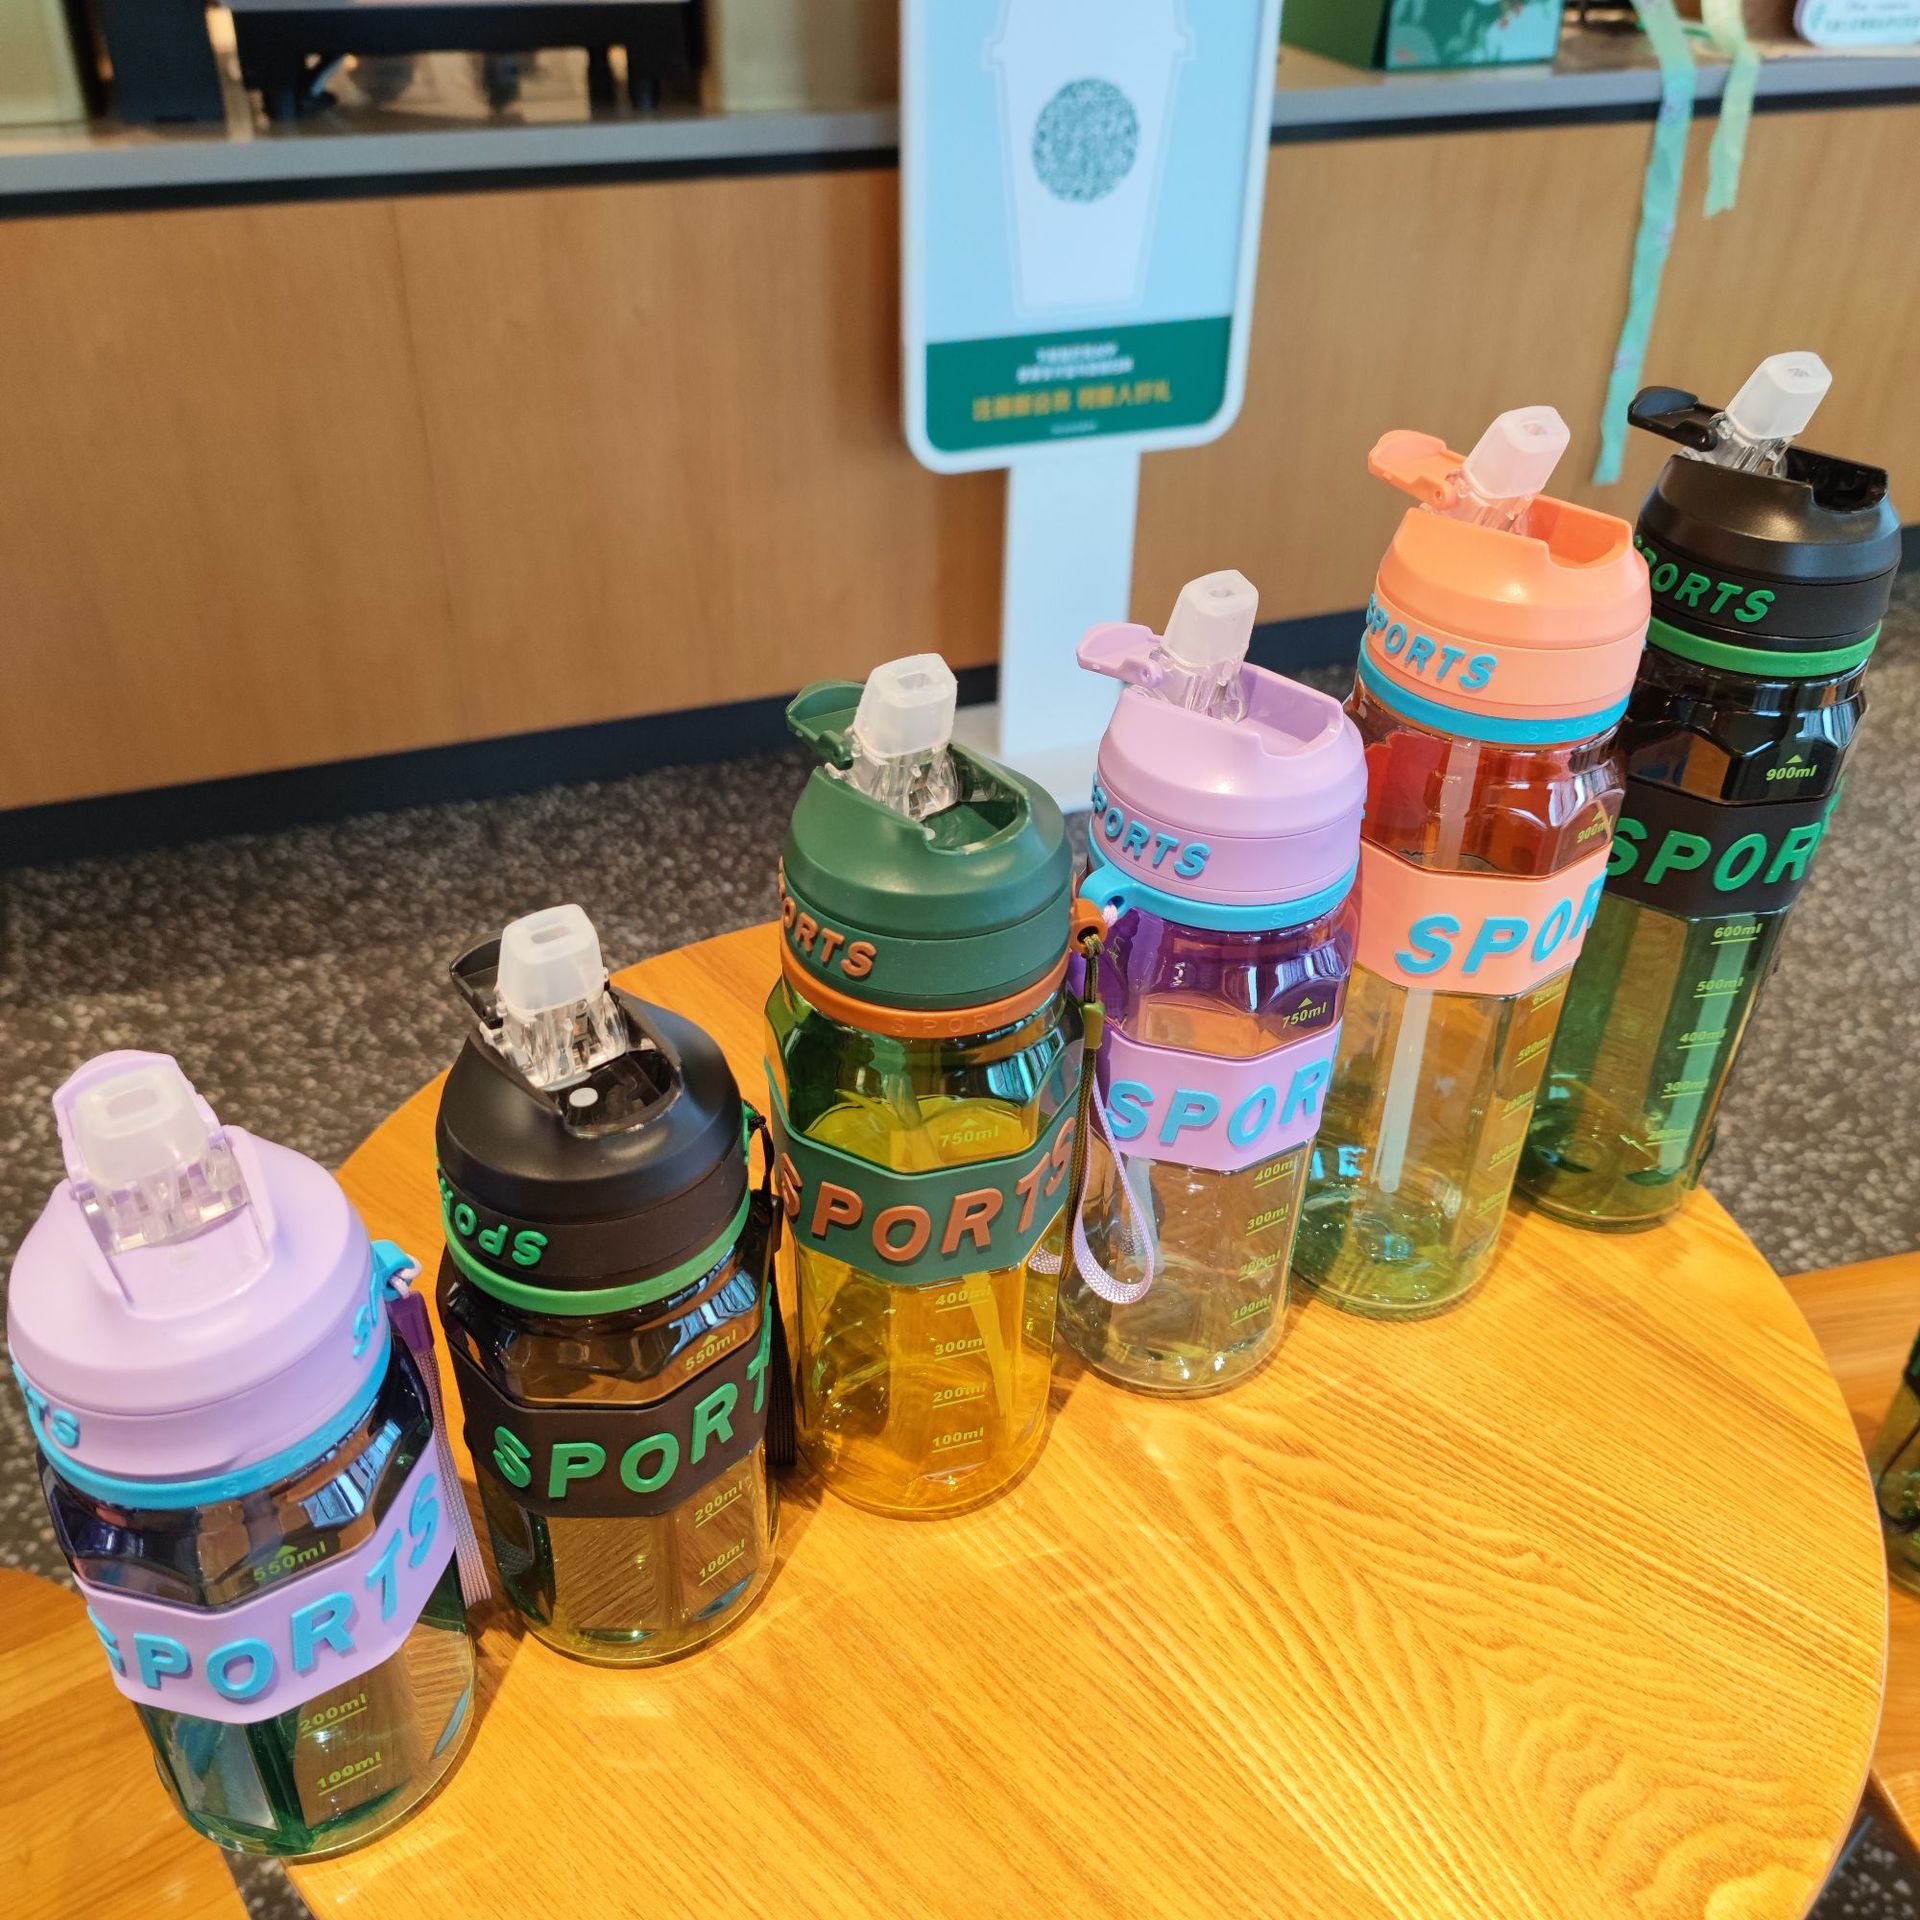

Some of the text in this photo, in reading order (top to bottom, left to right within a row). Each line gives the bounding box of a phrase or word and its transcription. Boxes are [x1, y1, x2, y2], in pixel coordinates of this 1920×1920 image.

[1765, 764, 1818, 781] 900ml
[1092, 771, 1211, 878] PORTS
[1606, 775, 1848, 893] SPOR
[778, 855, 877, 977] ORTS
[1713, 923, 1763, 939] 600ml
[1695, 977, 1744, 992] 500ml
[1282, 1001, 1327, 1029] 750ml
[1106, 1022, 1342, 1147] SPOR
[940, 1126, 1000, 1148] 750ml
[780, 1117, 1078, 1262] SPORTS
[1247, 1203, 1290, 1230] 300ml
[1231, 1293, 1272, 1320] 100ml
[685, 1328, 738, 1372] 550ml
[493, 1283, 771, 1498] SPORT
[932, 1427, 984, 1447] 100ml
[694, 1481, 744, 1523] 200ml
[252, 1541, 328, 1582] 550ml
[698, 1538, 745, 1579] 100ml
[86, 1474, 438, 1698] SPORTS
[300, 1693, 367, 1733] 200ml
[316, 1751, 381, 1789] 100ml
